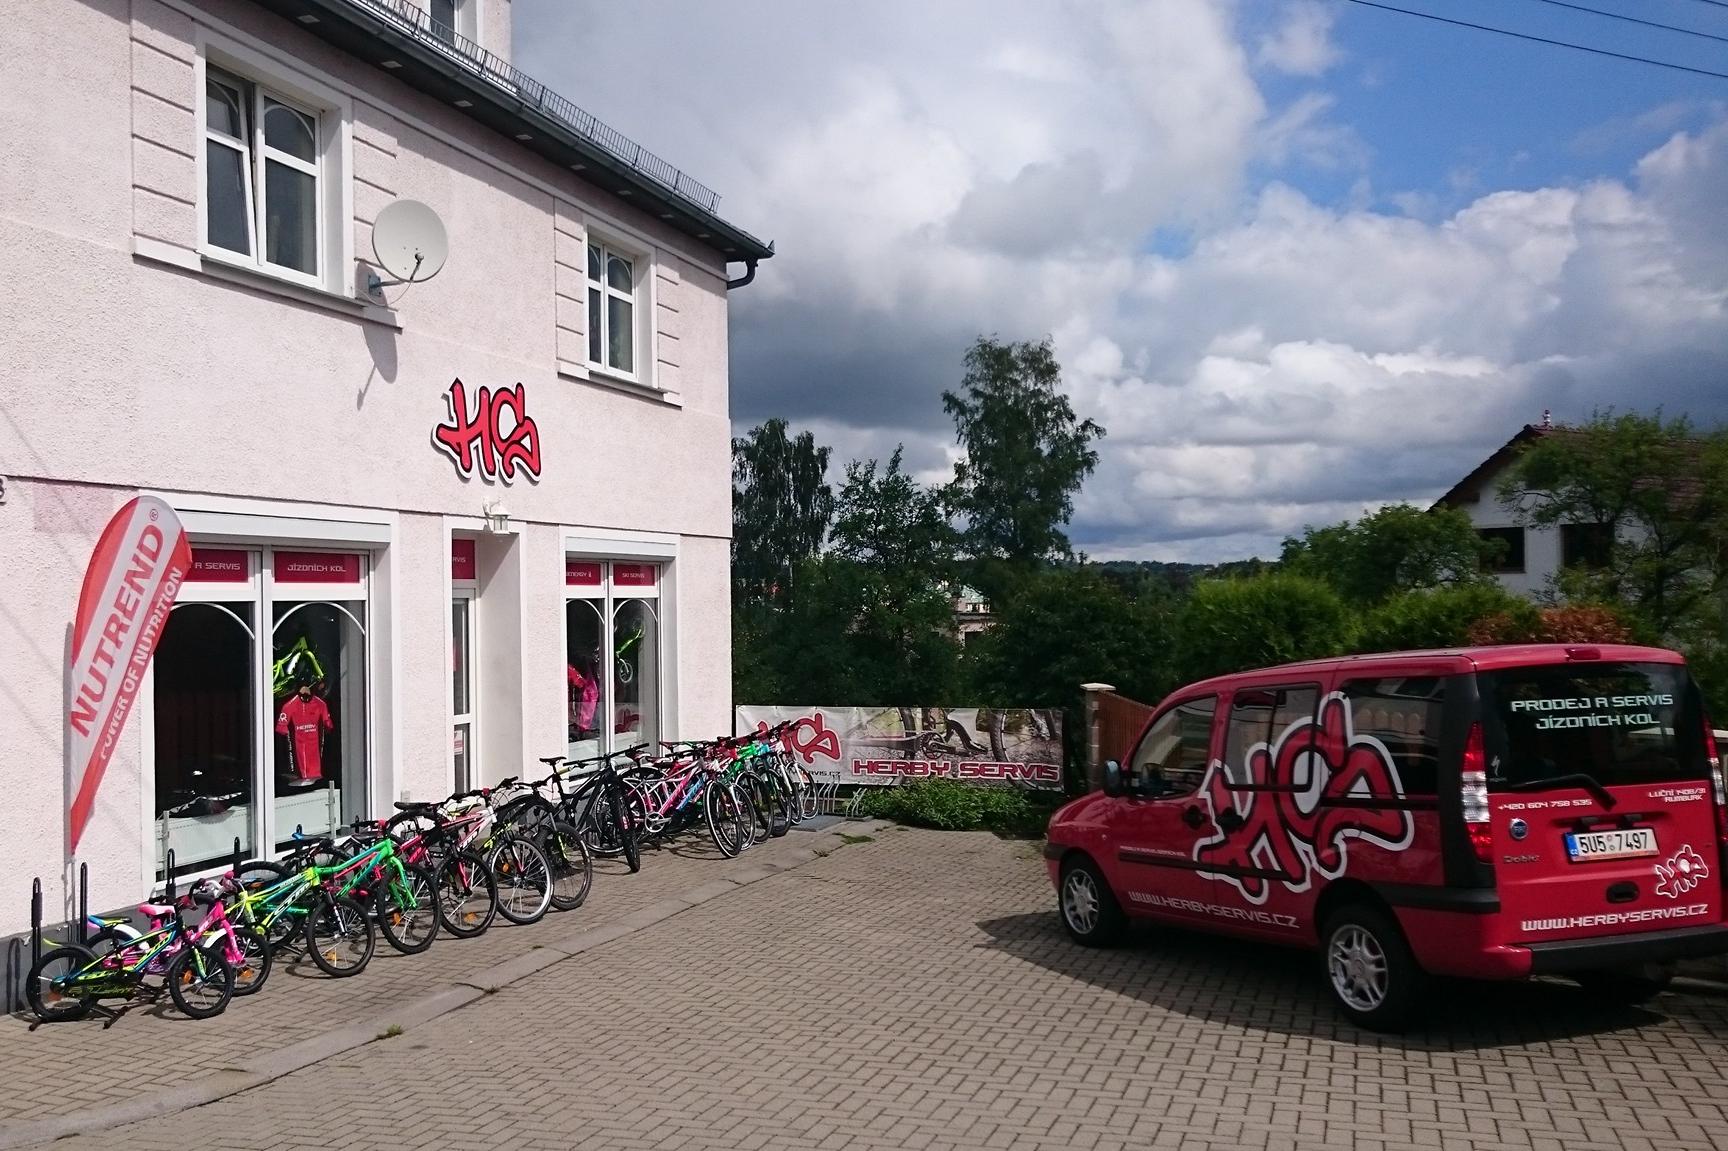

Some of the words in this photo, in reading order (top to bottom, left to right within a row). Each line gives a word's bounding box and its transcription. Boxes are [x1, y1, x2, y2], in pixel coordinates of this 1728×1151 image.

[205, 562, 241, 571] SERVIS
[330, 565, 347, 573] KOL
[70, 524, 164, 738] NUTREND
[123, 669, 140, 694] OF
[134, 566, 183, 668] NUTRITION
[1511, 698, 1591, 712] PRODEJ
[1595, 696, 1609, 708] A
[1612, 694, 1674, 707] SERVIS
[1624, 714, 1661, 725] KOL
[853, 758, 950, 778] HERBY
[959, 760, 1060, 782] SERVIS
[1578, 835, 1607, 854] 5U5
[1614, 832, 1647, 852] 7497
[1128, 890, 1300, 929] WWW.HERBYSERVIS.CZ
[1521, 903, 1709, 931] WWW.HERBYSERVIS.CZ
